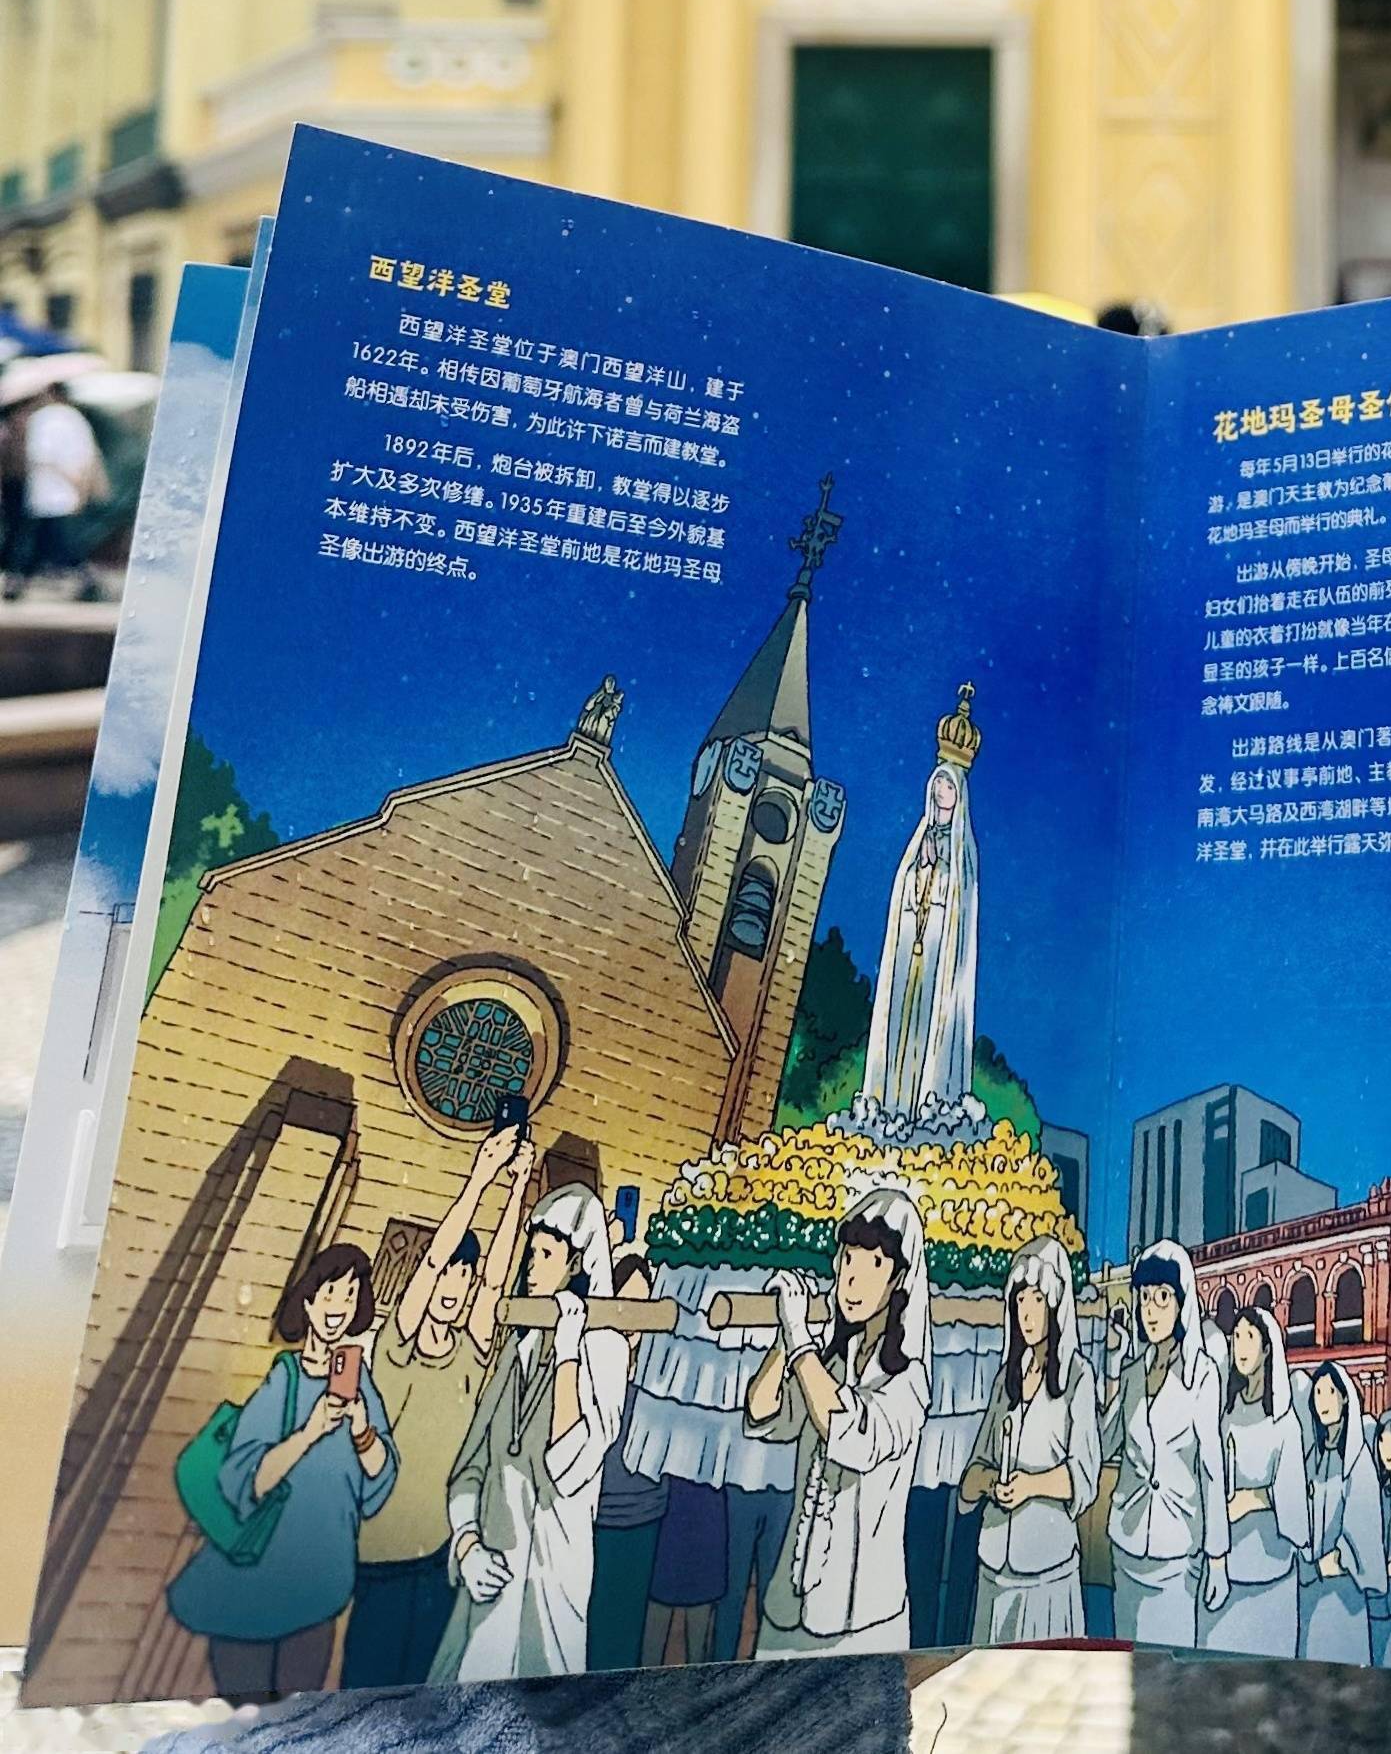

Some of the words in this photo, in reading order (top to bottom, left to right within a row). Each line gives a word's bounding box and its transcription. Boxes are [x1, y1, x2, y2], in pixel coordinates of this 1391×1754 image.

[369, 254, 511, 309] 西望洋圣堂
[399, 313, 744, 403] 西望洋圣堂位于澳门西望洋山，建于
[352, 341, 740, 436] 1622年。相传因葡萄牙航海者曾与荷兰海盗
[324, 497, 721, 583] 本维持不变。西望洋圣堂前地是花地玛圣母
[1207, 506, 1386, 545] 花地玛圣母而举行的典礼。
[319, 533, 478, 581] 圣像出游的终点。
[1201, 690, 1289, 716] 念祷文跟随。
